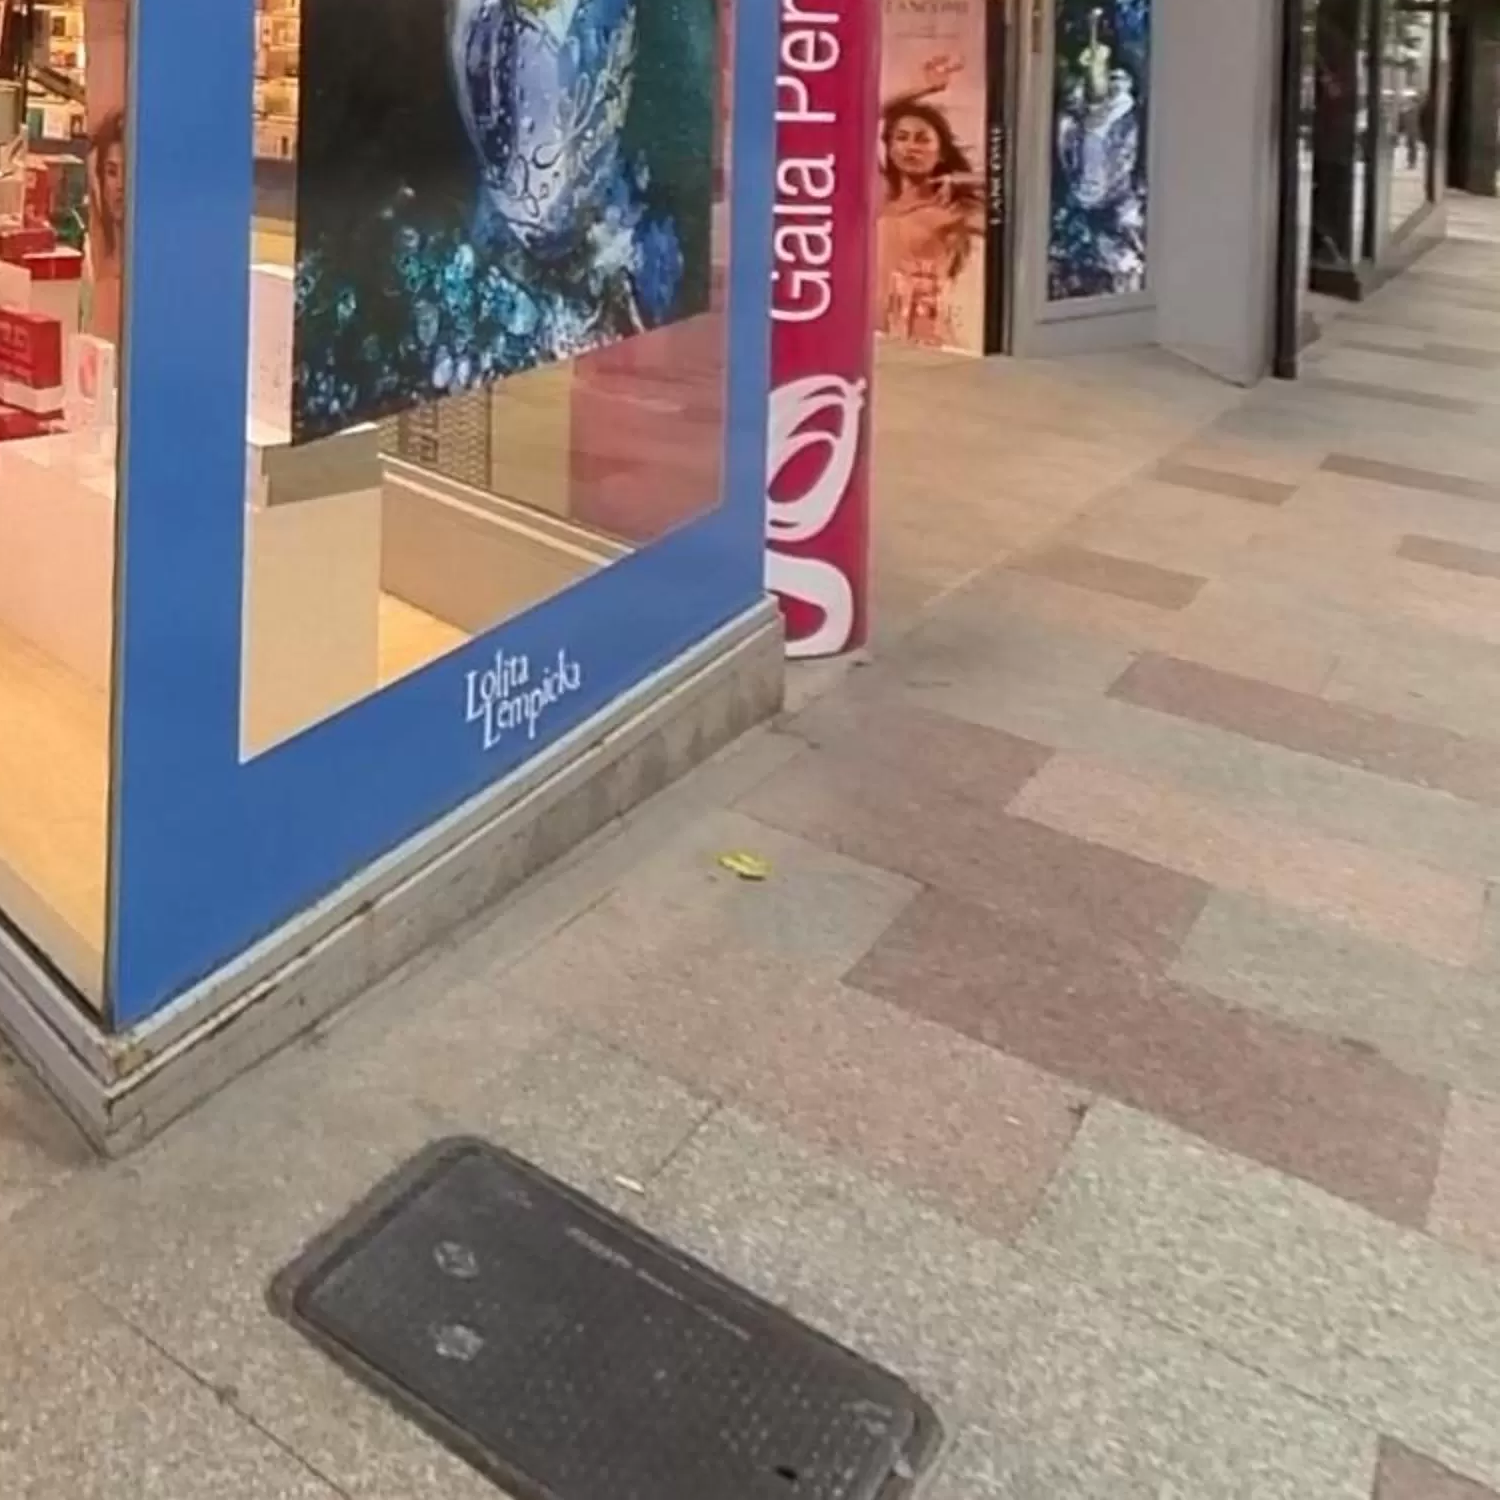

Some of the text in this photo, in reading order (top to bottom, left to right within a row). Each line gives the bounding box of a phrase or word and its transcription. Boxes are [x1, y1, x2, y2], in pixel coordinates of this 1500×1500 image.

[770, 153, 836, 322] Gala
[465, 648, 529, 723] Lolita
[484, 648, 581, 750] Lempicka
